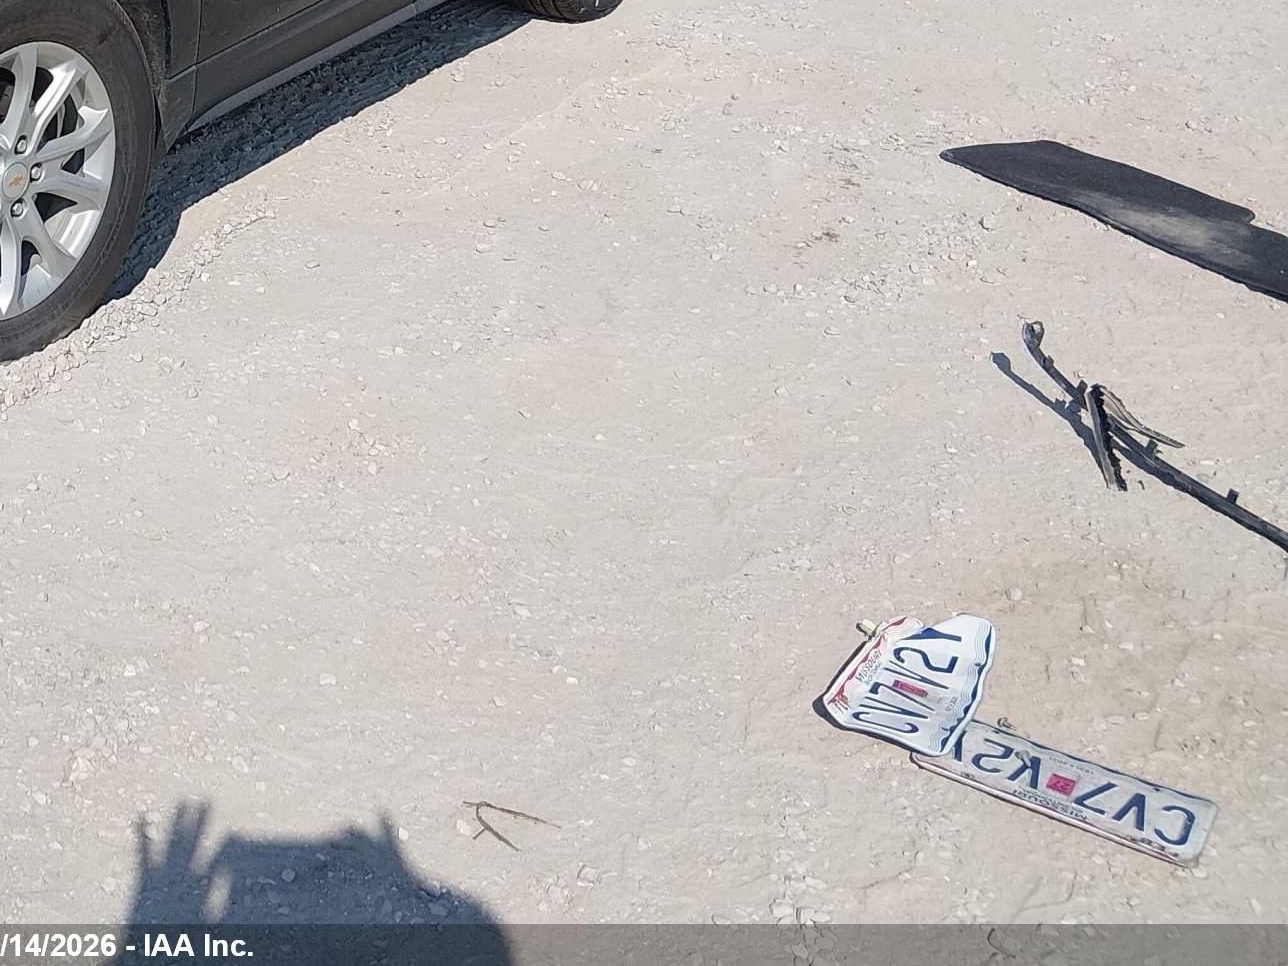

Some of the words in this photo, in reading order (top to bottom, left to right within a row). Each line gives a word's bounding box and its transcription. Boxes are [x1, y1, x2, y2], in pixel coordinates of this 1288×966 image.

[852, 682, 935, 733] CV7
[1013, 790, 1088, 821] MISSOURI
[1073, 781, 1196, 846] CV7
